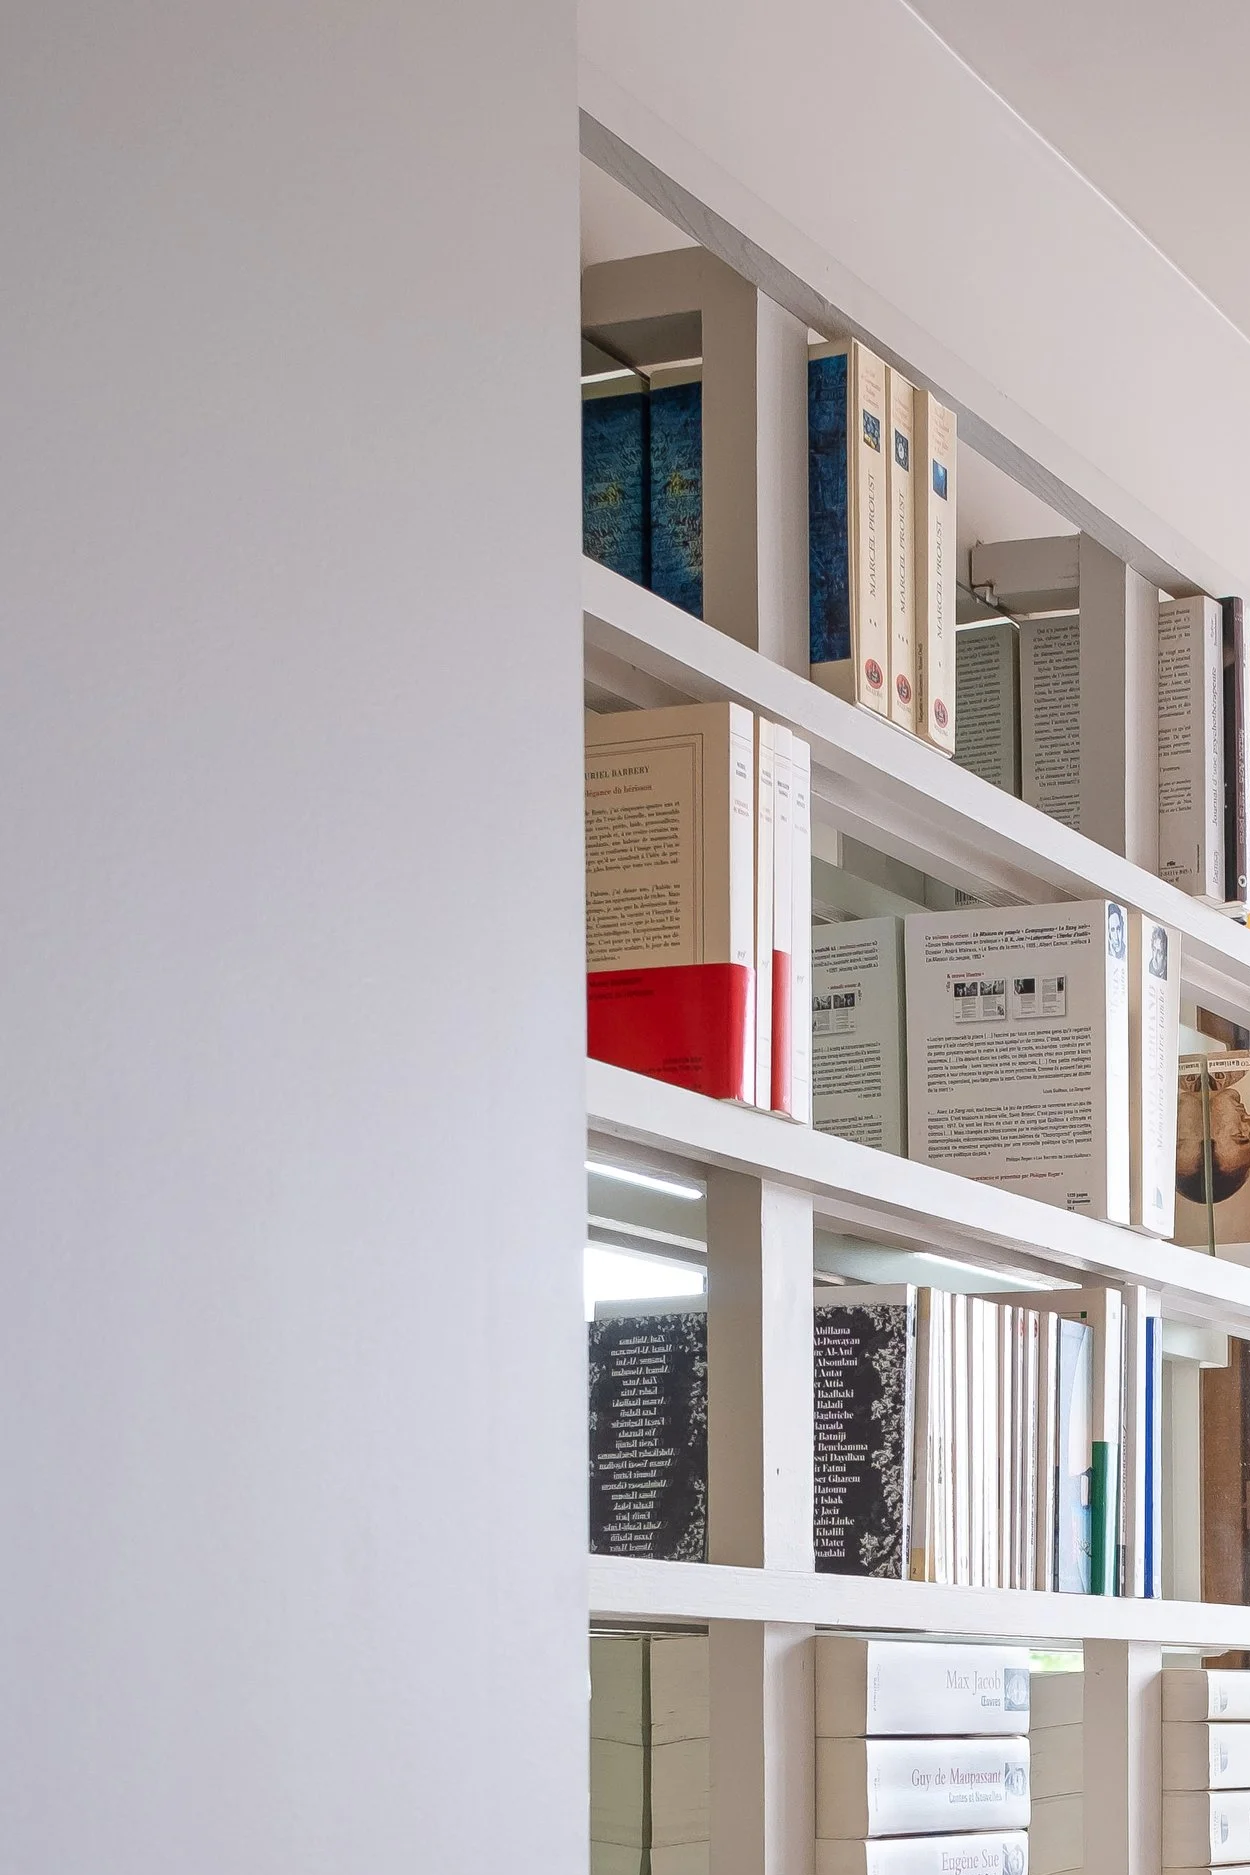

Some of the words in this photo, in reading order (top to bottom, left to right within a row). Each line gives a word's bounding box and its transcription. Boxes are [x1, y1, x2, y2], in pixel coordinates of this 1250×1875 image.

[868, 469, 876, 533] PROUST
[899, 488, 907, 549] PROUST
[936, 516, 944, 578] PROUST
[936, 582, 944, 640] MARCEL
[586, 770, 610, 780] URIEL
[611, 765, 650, 778] BARBERY
[1211, 789, 1220, 826] Journal
[1156, 988, 1165, 1084] d'outre-tombe
[1156, 1087, 1165, 1150] Mémoires
[817, 1400, 844, 1409] Baladi
[819, 1432, 847, 1442] Batniji
[818, 1443, 868, 1452] Benchamma
[822, 1464, 846, 1473] Fatmi
[828, 1475, 860, 1483] Gharem
[821, 1496, 843, 1504] Ishak
[821, 1506, 840, 1515] Jacir
[816, 1527, 845, 1536] Khalili
[821, 1538, 844, 1547] Mater
[946, 1669, 970, 1690] Max
[973, 1670, 1001, 1695] Jacob
[911, 1768, 932, 1791] Guy
[934, 1767, 946, 1785] de
[949, 1767, 1001, 1789] Maupassant
[941, 1850, 979, 1875] Eugène
[981, 1849, 1000, 1868] Sue
